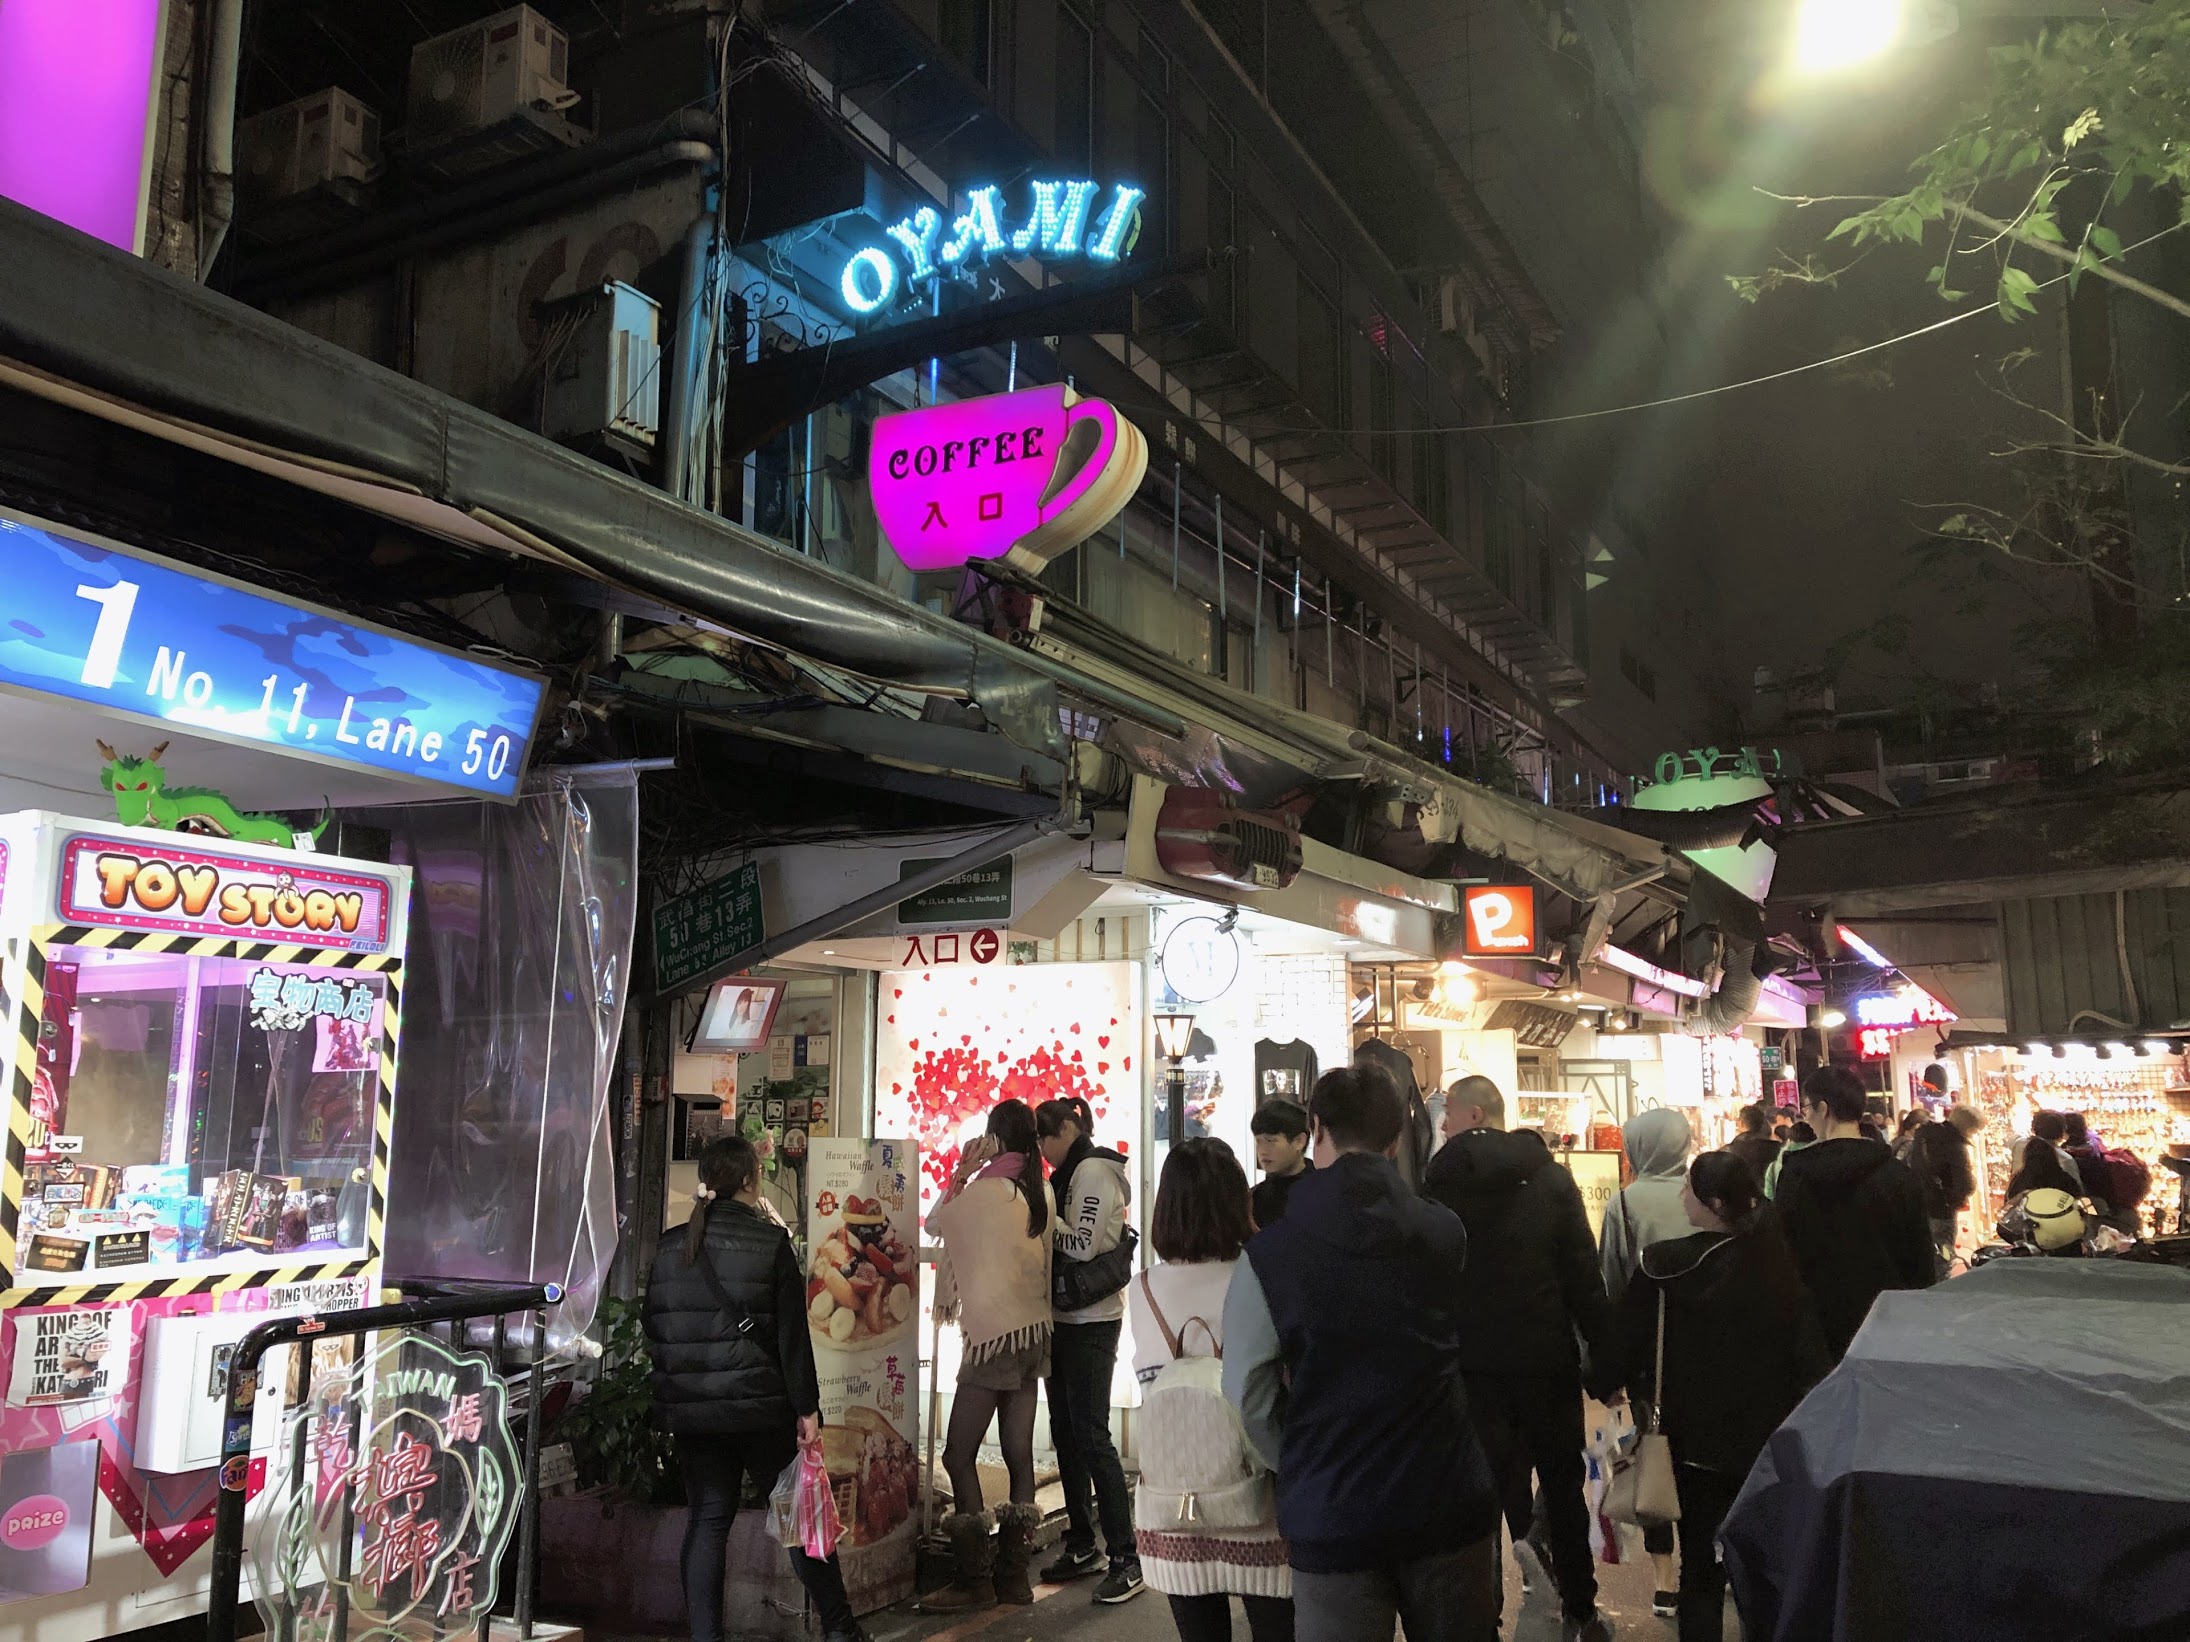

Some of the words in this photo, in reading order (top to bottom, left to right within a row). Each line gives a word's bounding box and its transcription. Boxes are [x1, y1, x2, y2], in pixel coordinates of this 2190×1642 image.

[841, 180, 1146, 314] OYAMI
[888, 427, 1044, 479] COFFEE
[921, 492, 1003, 532] 入口
[260, 674, 317, 741] 11,
[335, 695, 442, 762] Lane
[461, 734, 511, 782] 50
[96, 852, 219, 917] TOY
[219, 883, 363, 934] STORY
[666, 965, 690, 983] Lane
[712, 942, 737, 962] Alley
[741, 932, 752, 947] 13
[901, 934, 959, 967] 入口
[250, 966, 374, 1024] 宝物商店
[825, 1151, 862, 1160] Hawaiian
[849, 1160, 875, 1174] Waffle
[1079, 1196, 1100, 1225] ONE
[2057, 1194, 2071, 1209] BELL
[309, 1224, 326, 1234] KING
[327, 1223, 337, 1231] OF
[310, 1231, 337, 1242] ARTIST
[34, 1358, 59, 1374] THE
[349, 1367, 457, 1414] TAIWAN
[846, 1381, 872, 1397] Waffle
[437, 1550, 481, 1618] 店
